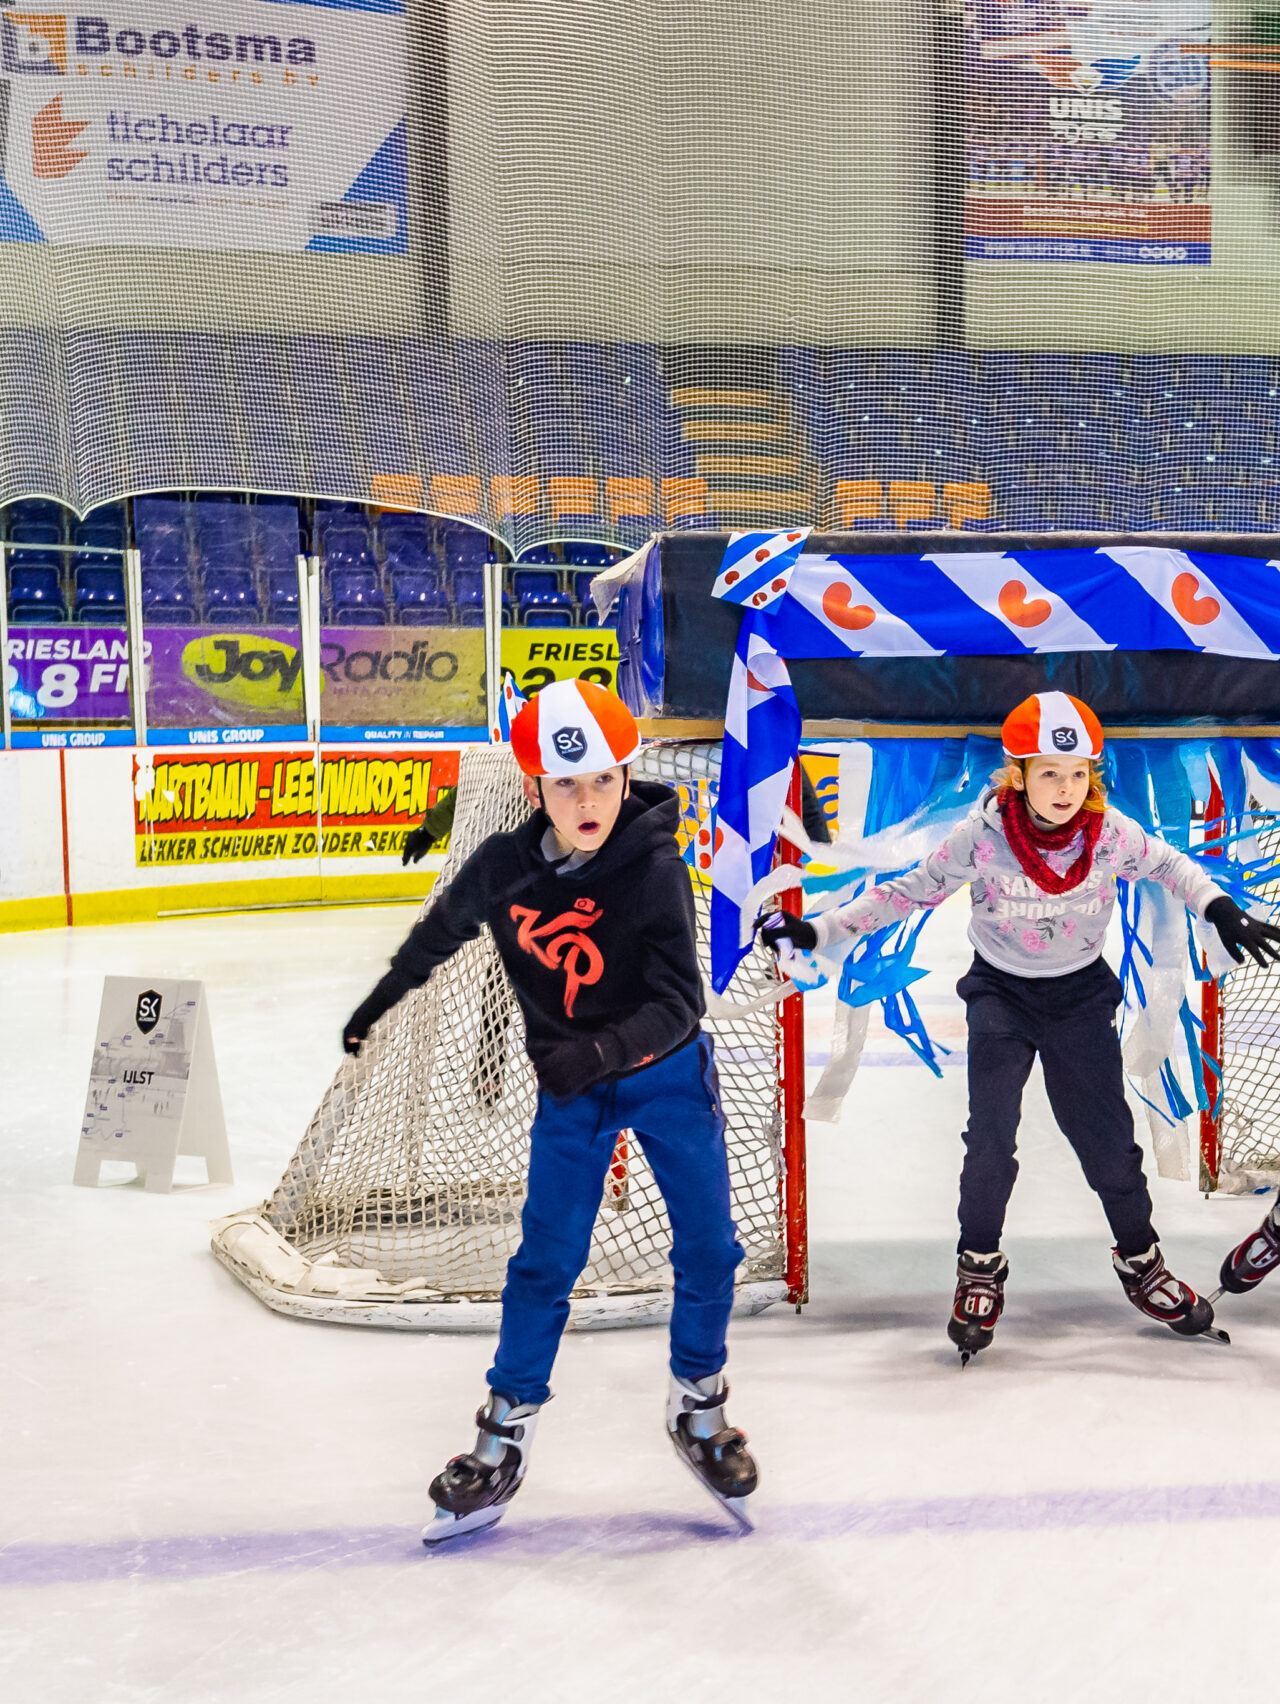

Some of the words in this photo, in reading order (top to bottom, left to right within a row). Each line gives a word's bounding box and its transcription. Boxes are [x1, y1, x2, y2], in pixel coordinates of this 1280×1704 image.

[74, 16, 317, 64] Bootsma
[77, 64, 263, 84] schilders
[284, 69, 319, 87] bv
[106, 109, 293, 149] tichelaar
[106, 152, 290, 188] schilders
[320, 640, 459, 683] Radio
[528, 642, 620, 661] FRIESL
[195, 640, 301, 693] Joy
[41, 733, 68, 748] UNIS
[70, 732, 106, 747] GROUP
[188, 731, 219, 744] UNIS
[222, 729, 265, 743] GROUP
[364, 730, 403, 740] QUALITY
[140, 838, 196, 862] LEKKER
[200, 833, 288, 859] SCHEUREN
[139, 997, 160, 1018] SK
[122, 1069, 155, 1086] IJLST
